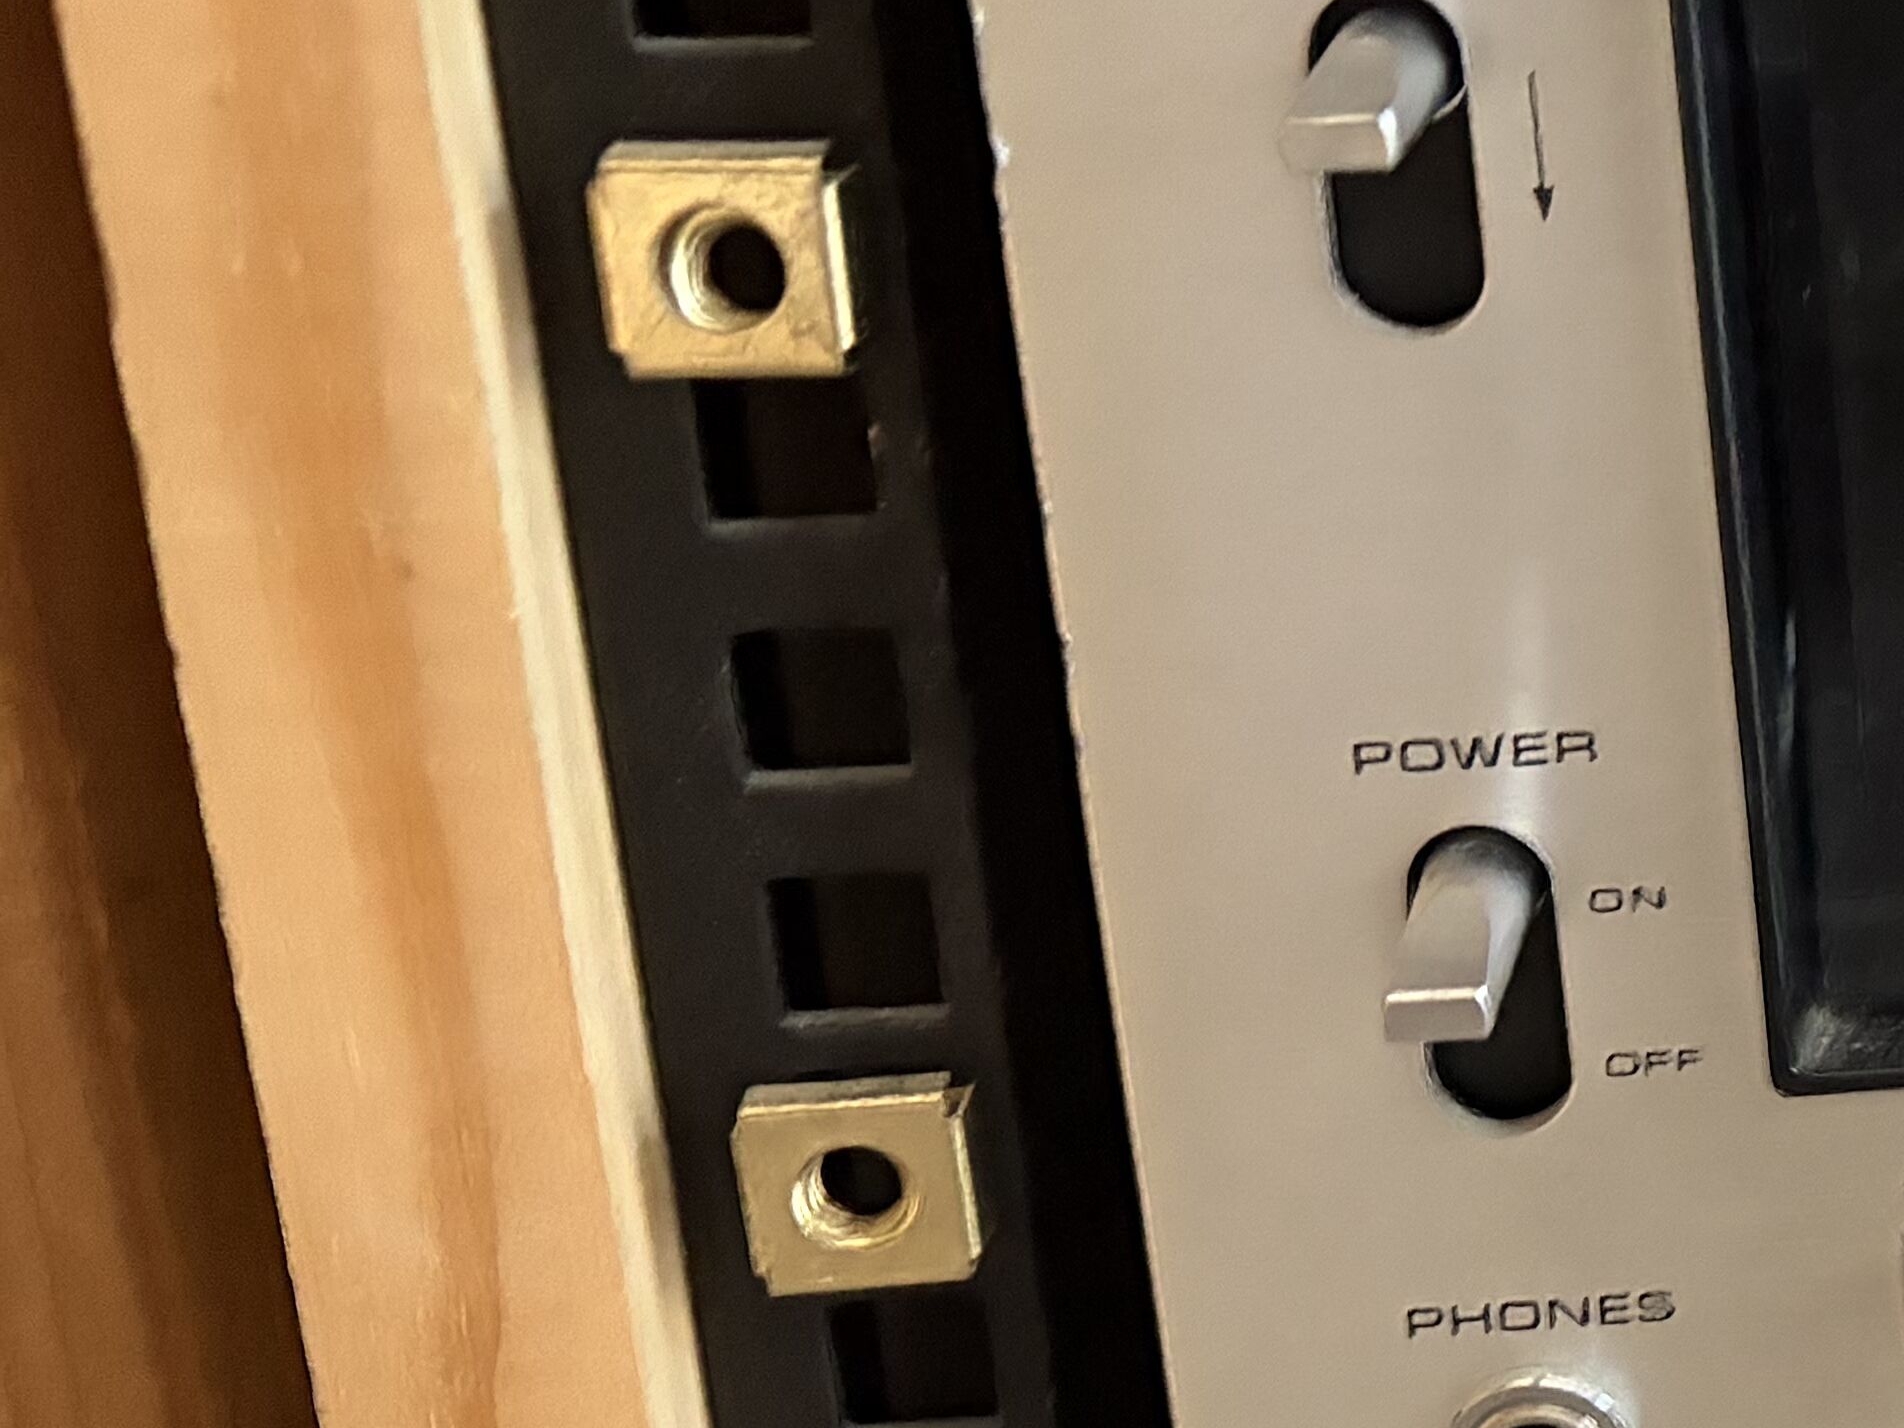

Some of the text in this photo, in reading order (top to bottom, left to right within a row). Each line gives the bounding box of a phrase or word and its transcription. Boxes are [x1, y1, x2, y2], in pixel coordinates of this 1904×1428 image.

[1352, 730, 1598, 772] POWER
[1588, 884, 1668, 914] ON
[1605, 1048, 1704, 1078] OFF
[1406, 1292, 1676, 1338] PHONES
